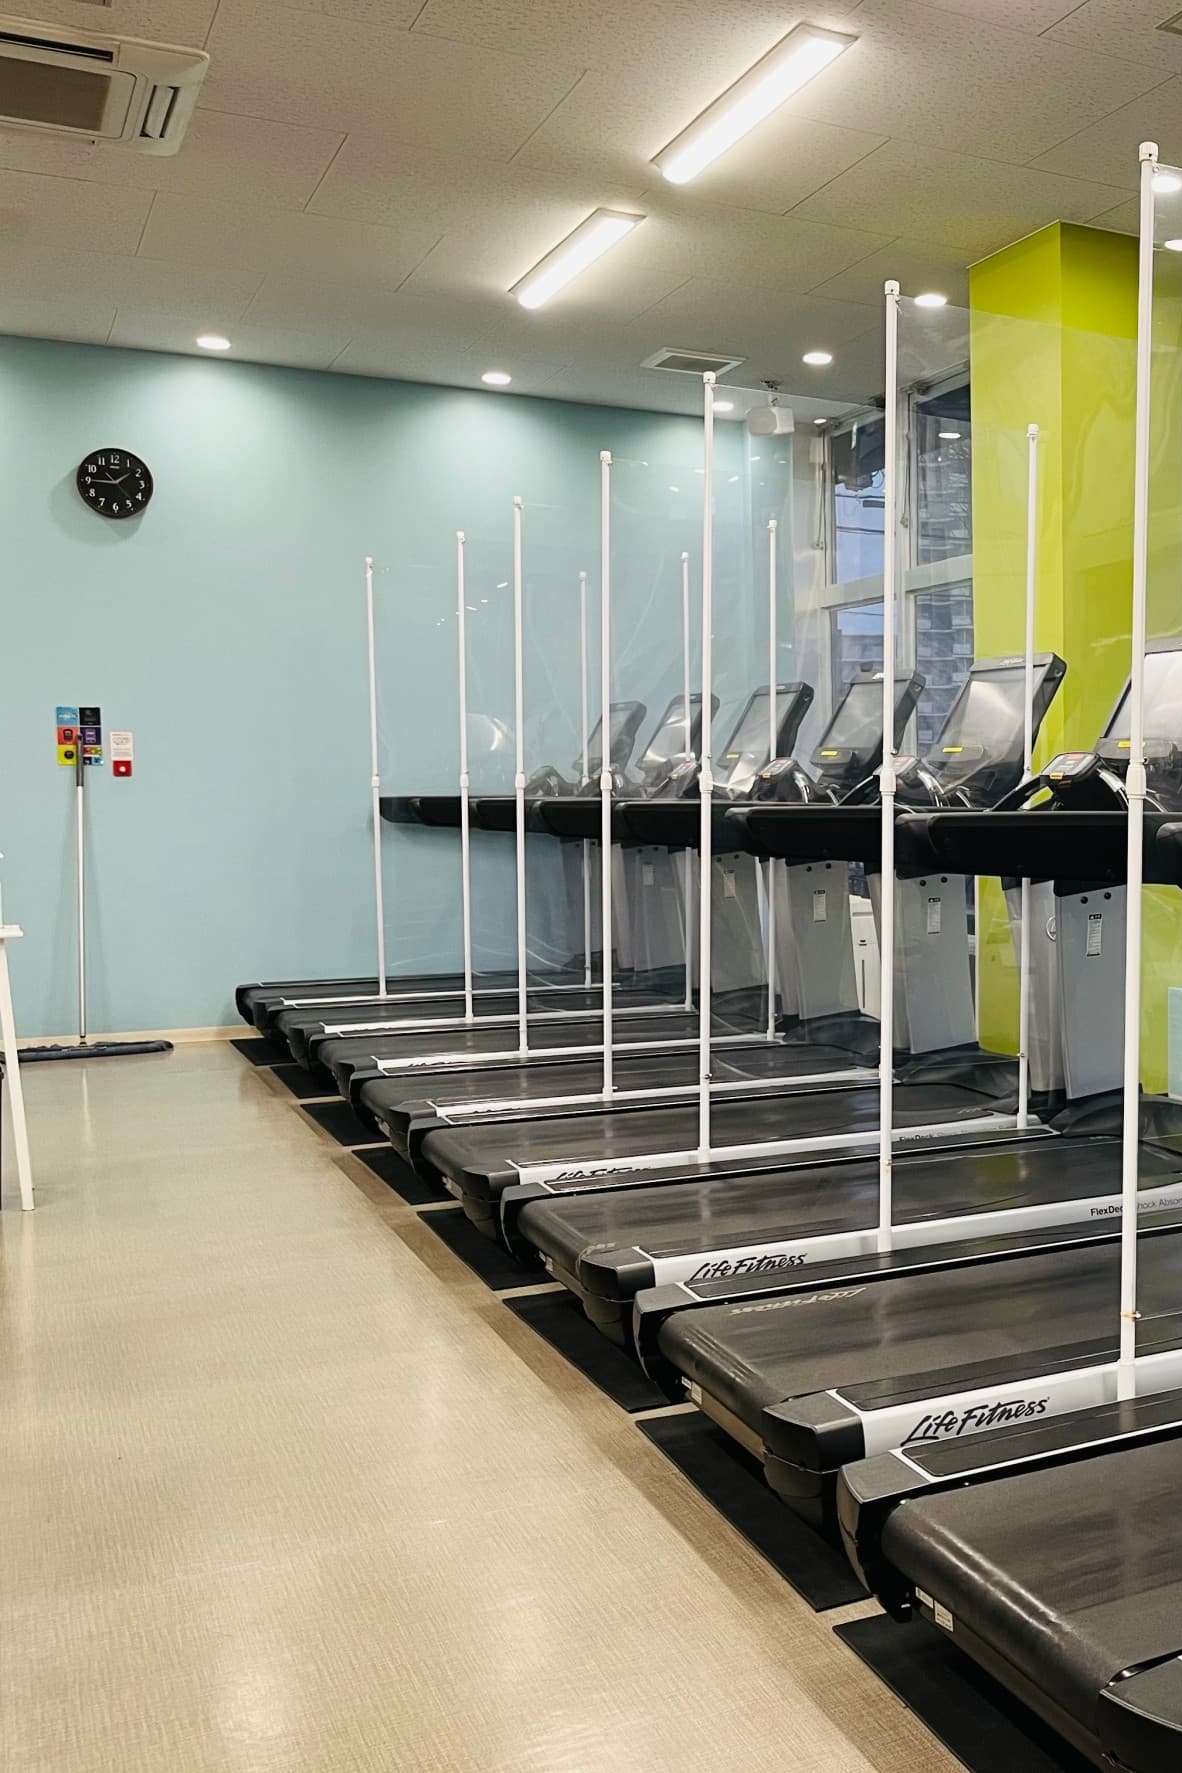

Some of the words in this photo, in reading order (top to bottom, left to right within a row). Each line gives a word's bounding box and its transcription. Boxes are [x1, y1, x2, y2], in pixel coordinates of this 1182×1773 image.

[98, 456, 106, 466] 11
[111, 455, 120, 464] 12
[88, 464, 97, 473] 10
[135, 468, 141, 477] 2
[85, 476, 91, 485] 9
[139, 480, 145, 489] 3
[89, 488, 95, 497] 8
[135, 492, 142, 501] 4
[99, 498, 105, 506] 7
[112, 502, 119, 511] 6
[126, 499, 132, 508] 5
[1090, 1205, 1124, 1216] FlexDec
